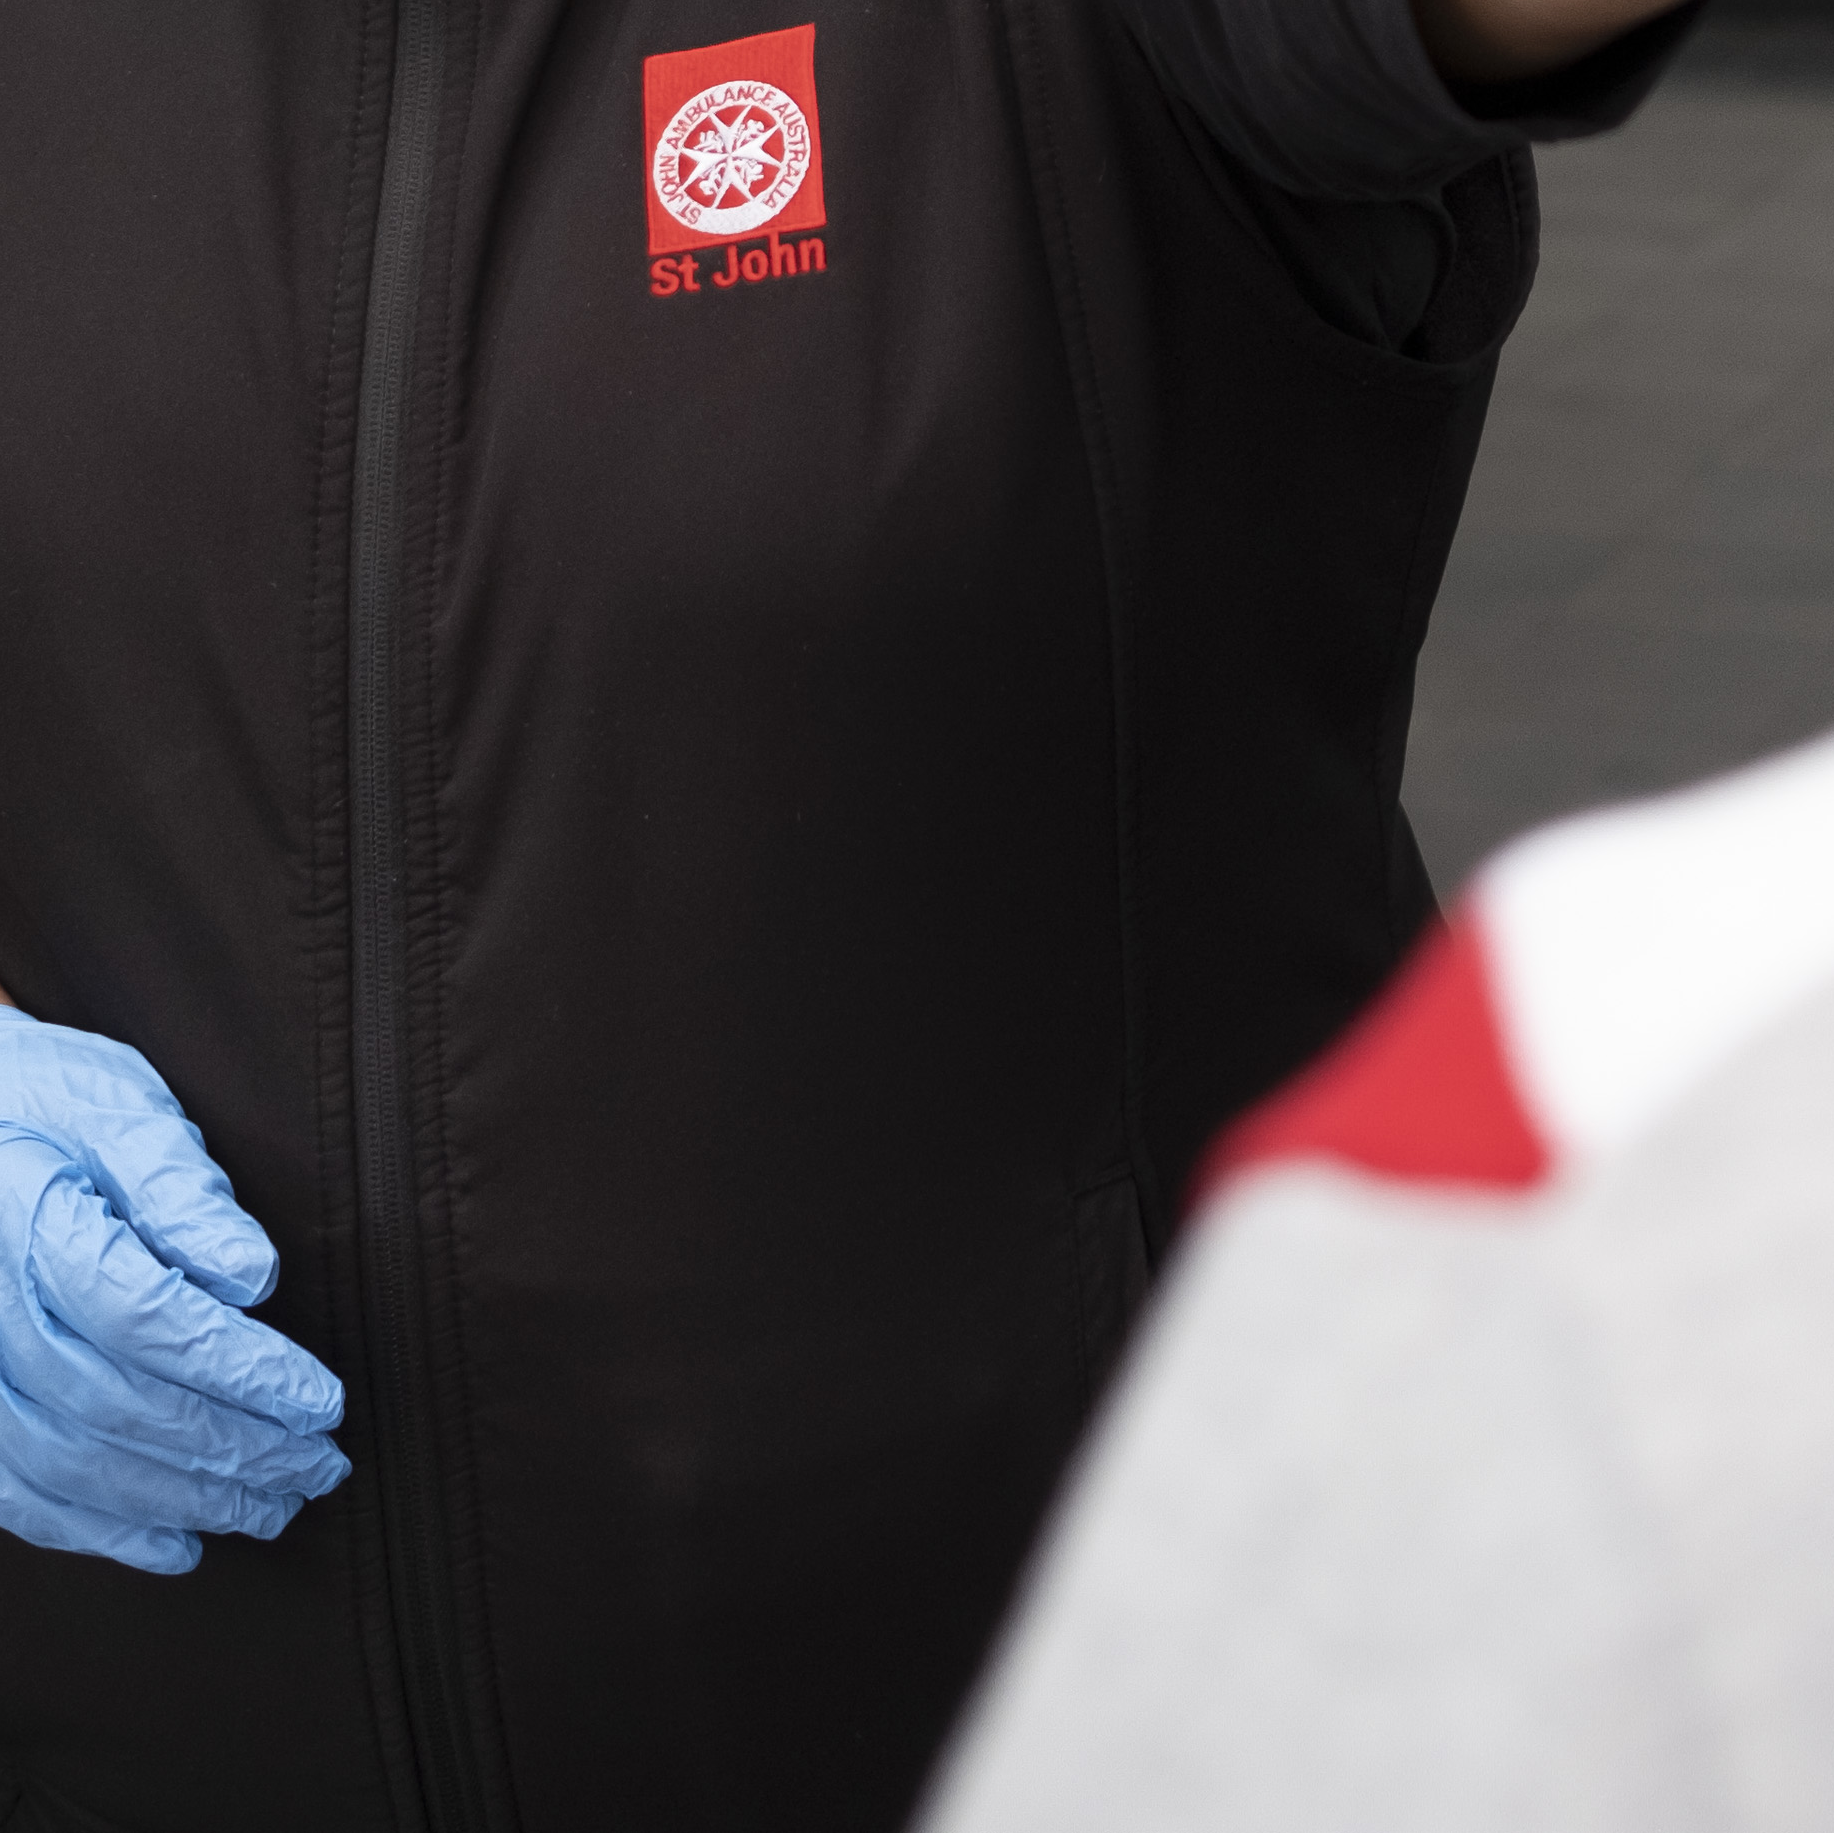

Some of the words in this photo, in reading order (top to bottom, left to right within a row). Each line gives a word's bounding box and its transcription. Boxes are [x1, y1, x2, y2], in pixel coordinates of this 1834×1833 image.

[667, 86, 776, 149] AMBULANCE
[659, 156, 684, 204] JOHN
[761, 102, 806, 209] AUSTRALIA
[676, 202, 701, 225] ST
[649, 254, 701, 296] St
[712, 233, 826, 288] John
